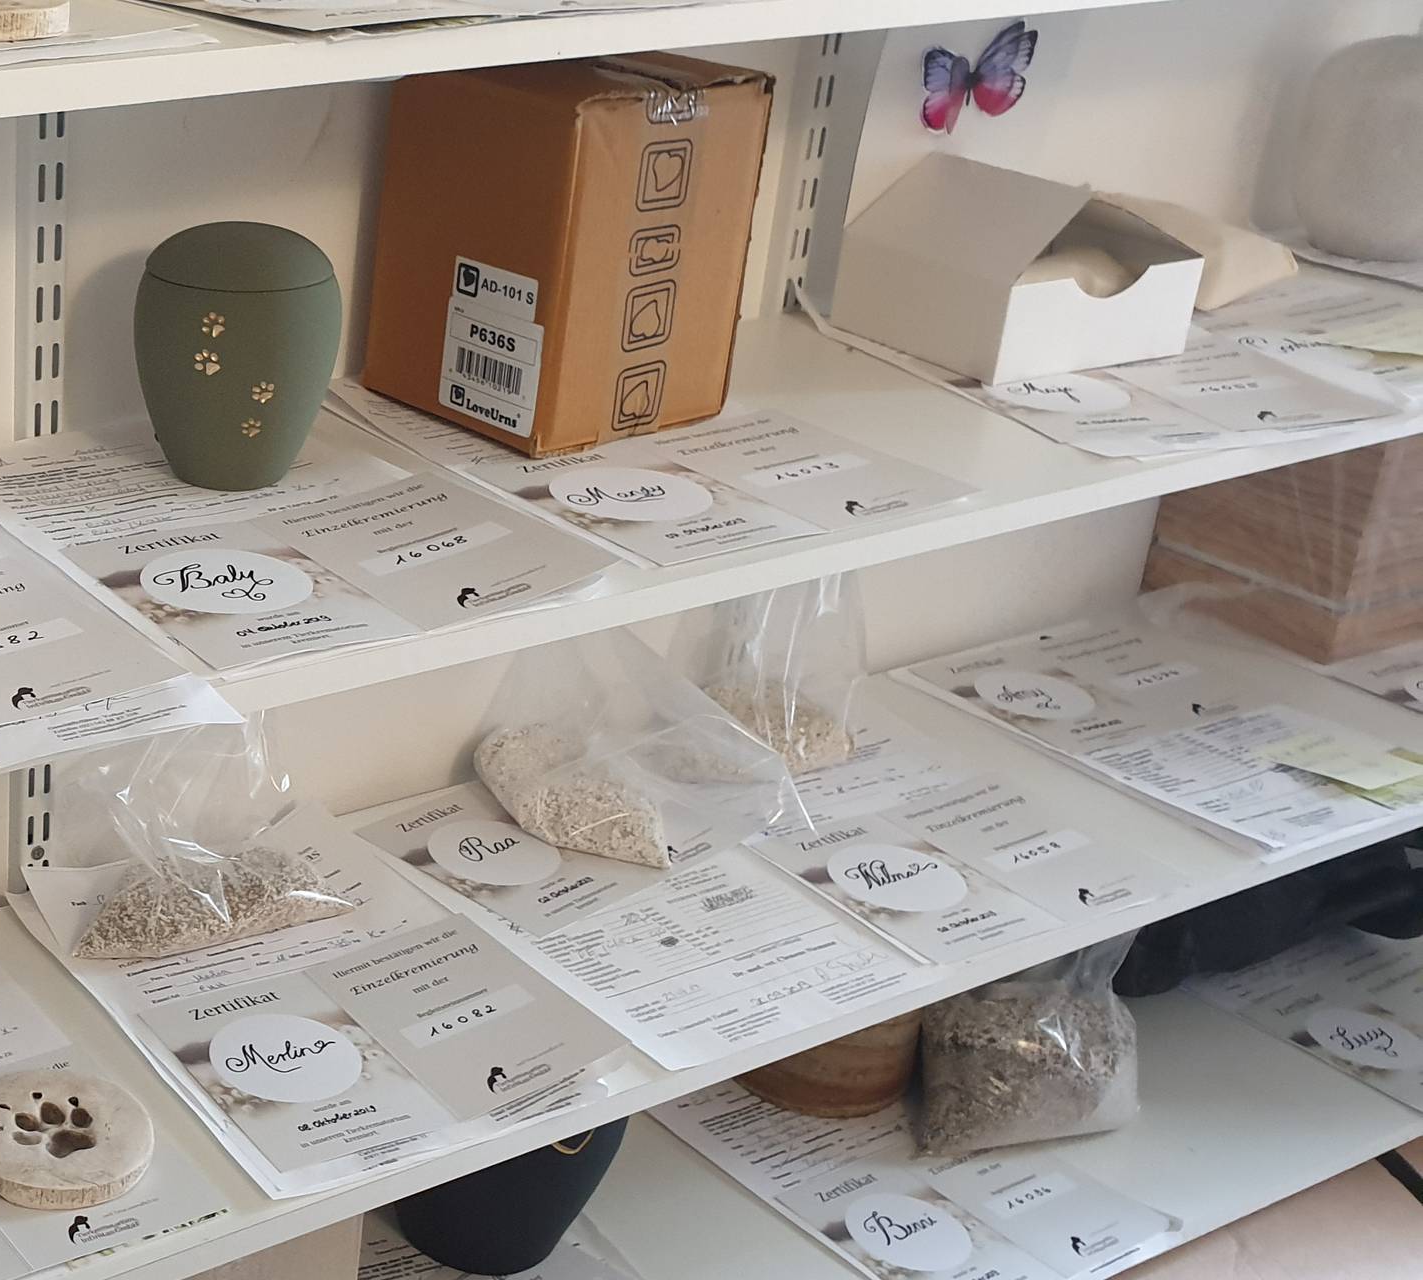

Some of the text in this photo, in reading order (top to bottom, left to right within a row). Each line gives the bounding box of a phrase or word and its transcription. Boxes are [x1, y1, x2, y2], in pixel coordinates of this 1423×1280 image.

[481, 278, 534, 305] AD-101 S
[470, 323, 516, 352] P636S
[466, 398, 518, 429] LoveUrns
[516, 452, 607, 474] Zertifikat
[300, 493, 448, 538] Einzelkremierung
[394, 520, 414, 530] der
[117, 531, 223, 556] Zertifikat
[395, 534, 468, 566] 16068
[395, 801, 466, 834] Zertifikat
[925, 794, 1026, 833] Einzelkremierung
[458, 834, 520, 862] Raa
[796, 826, 869, 853] Zertifikat
[331, 959, 372, 980] Hiermit
[371, 941, 425, 967] bestätigen
[424, 934, 444, 947] wir
[442, 927, 459, 940] die
[349, 943, 480, 997] Einzelkremierung
[412, 974, 451, 995] mit der
[188, 989, 282, 1022] Zertifikat
[429, 1003, 497, 1038] 16082
[53, 1060, 71, 1071] die
[313, 1099, 352, 1113] wurde am
[353, 1104, 377, 1118] 2019
[309, 1130, 345, 1147] unserem
[344, 1114, 412, 1137] Tierkrematorium
[815, 1174, 878, 1204] Zertifikat
